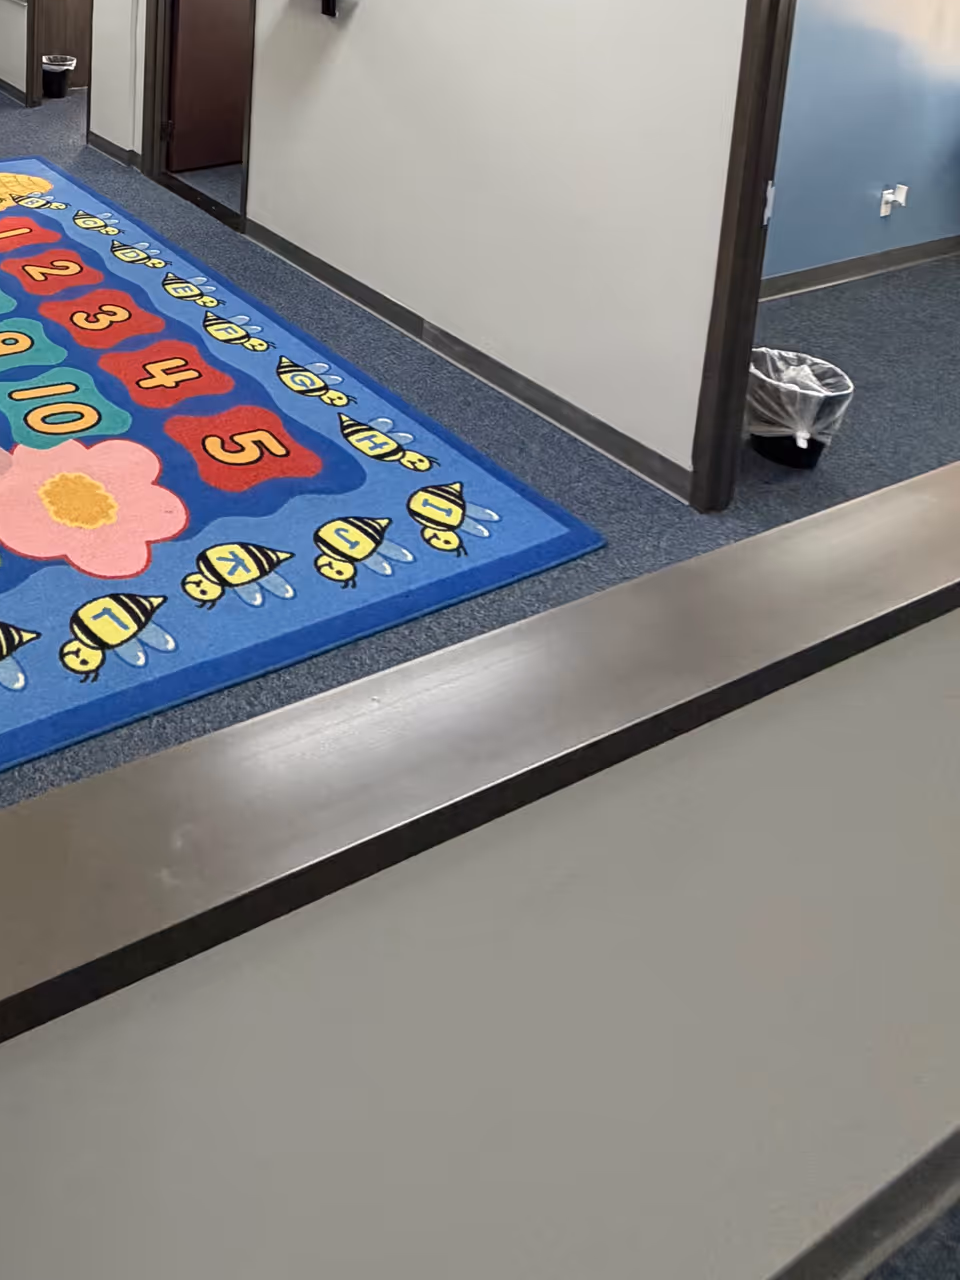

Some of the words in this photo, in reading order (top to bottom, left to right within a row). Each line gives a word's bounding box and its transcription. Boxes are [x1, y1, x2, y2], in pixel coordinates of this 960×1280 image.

[82, 218, 98, 226] C
[120, 250, 140, 259] D
[21, 258, 84, 283] 2
[172, 285, 195, 295] E
[70, 303, 132, 332] 3
[214, 327, 239, 336] F
[136, 356, 202, 391] 4
[289, 373, 317, 390] G
[8, 381, 102, 436] 10
[201, 427, 290, 467] 5
[355, 433, 391, 452] H
[333, 527, 360, 550] J
[216, 550, 252, 577] K
[90, 606, 131, 631] L
